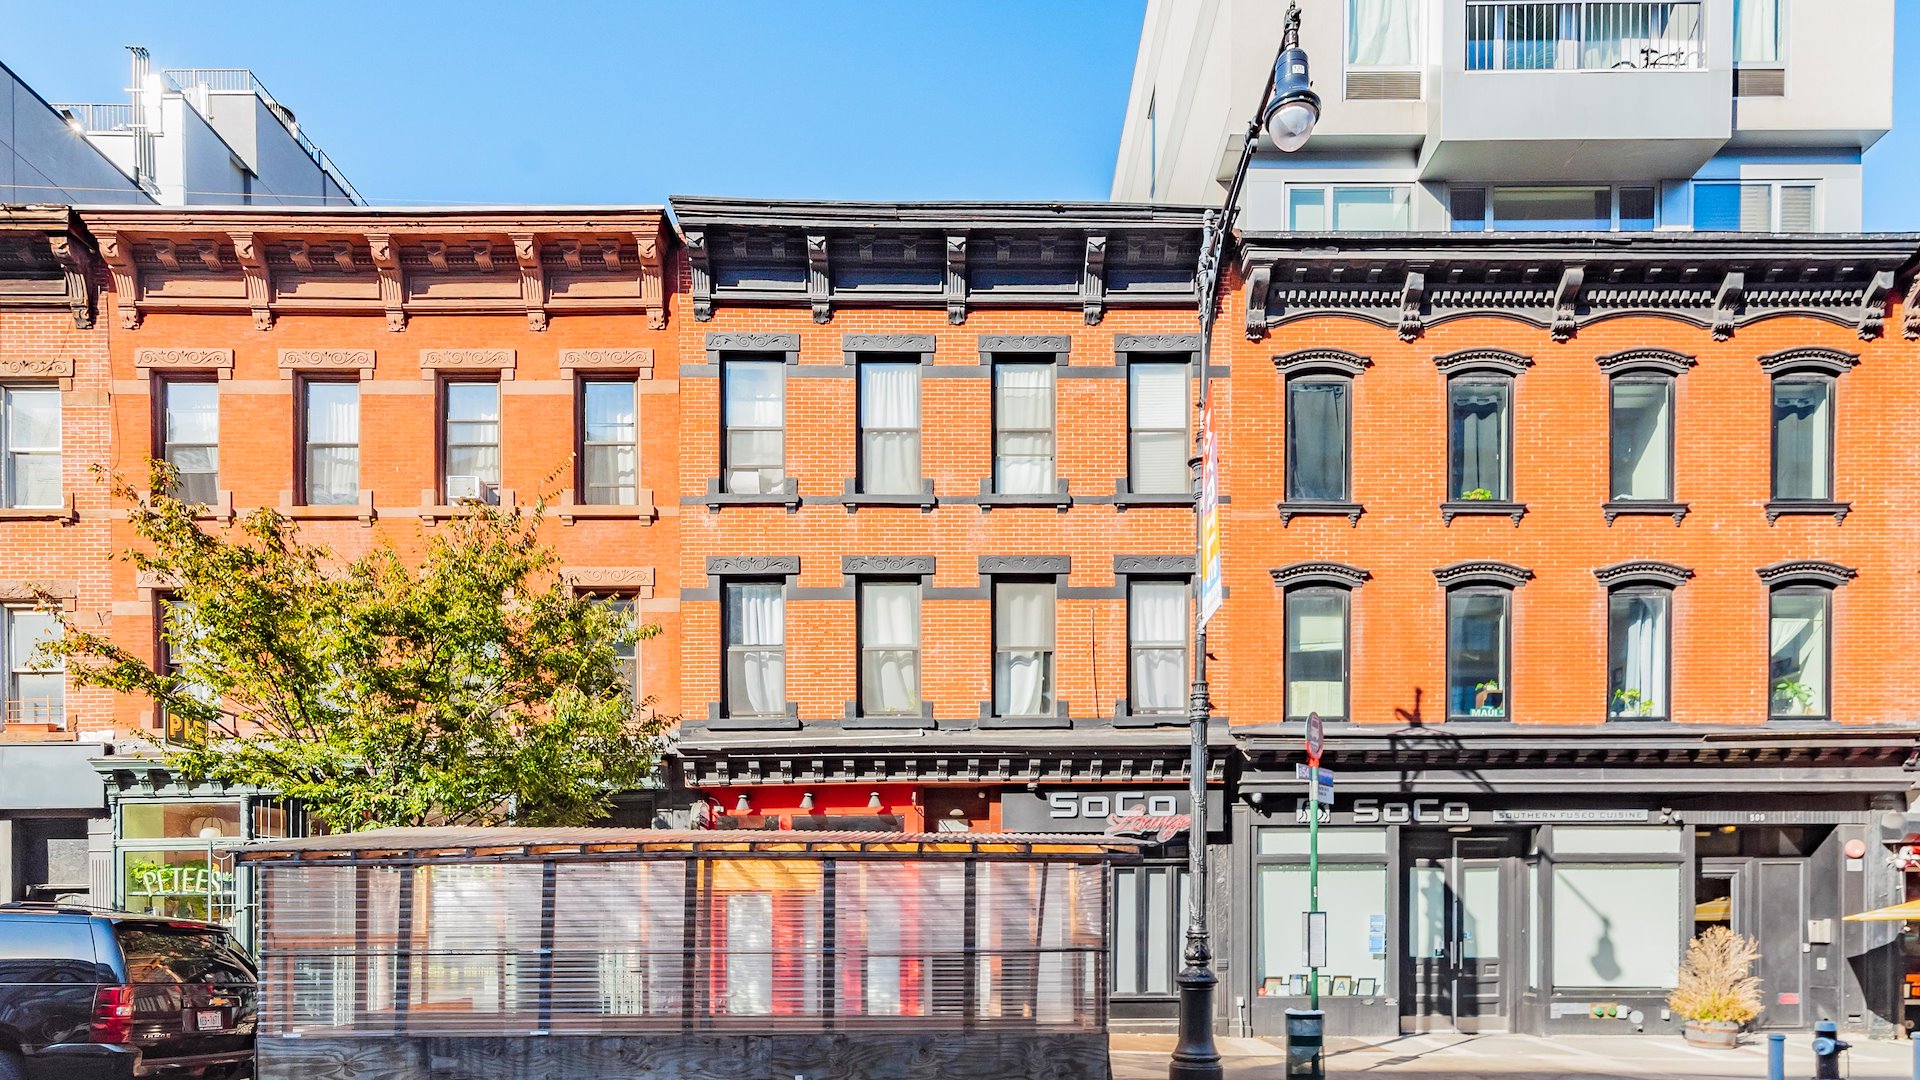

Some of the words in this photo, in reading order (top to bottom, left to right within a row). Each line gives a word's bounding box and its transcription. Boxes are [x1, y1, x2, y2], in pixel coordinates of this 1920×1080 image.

[1050, 791, 1177, 818] SoCo
[1353, 799, 1470, 823] SoCo
[1599, 811, 1643, 819] CUISINE
[1749, 813, 1765, 822] 509
